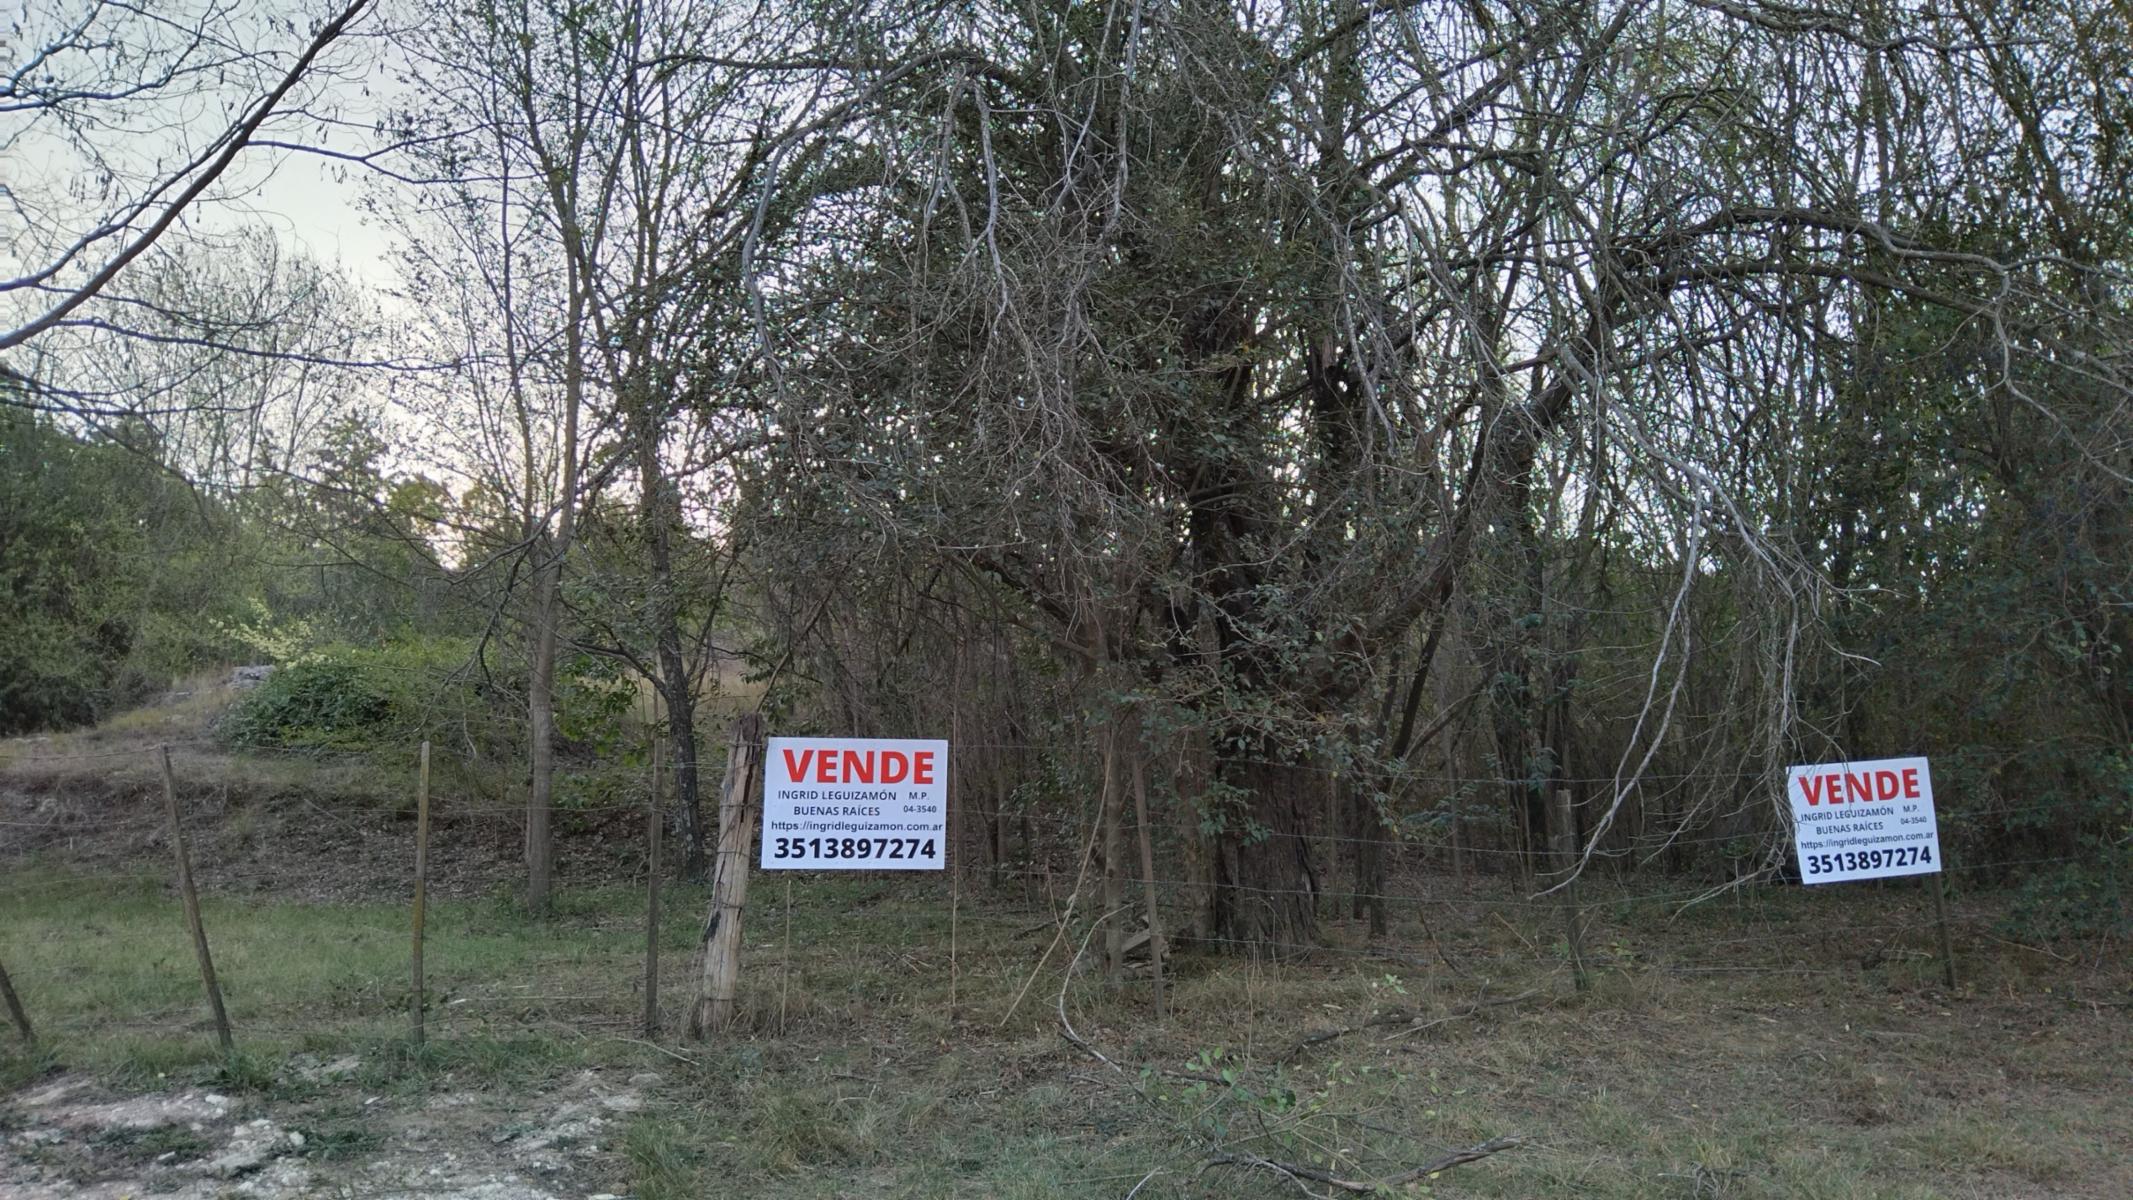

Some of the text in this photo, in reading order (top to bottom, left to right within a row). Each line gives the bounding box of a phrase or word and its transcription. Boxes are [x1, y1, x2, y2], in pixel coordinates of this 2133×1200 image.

[783, 749, 933, 784] VENDE
[1798, 768, 1920, 806] VENDE
[778, 790, 896, 800] INGRID LEGUIZAMÓN
[909, 792, 929, 800] M.P.
[794, 805, 880, 816] BUENAS RAÍCES
[904, 805, 936, 813] 04-3540
[1801, 806, 1894, 822] INGRID LEGUIZAMÓN
[771, 821, 942, 832] https://ingridleguizamon.com.ar
[1816, 822, 1883, 835] BUENAS RAÍCES
[1801, 832, 1934, 849] https://ingridleguizamon.com.ar
[774, 838, 936, 859] 3513897274
[1808, 846, 1931, 874] 3513897274
